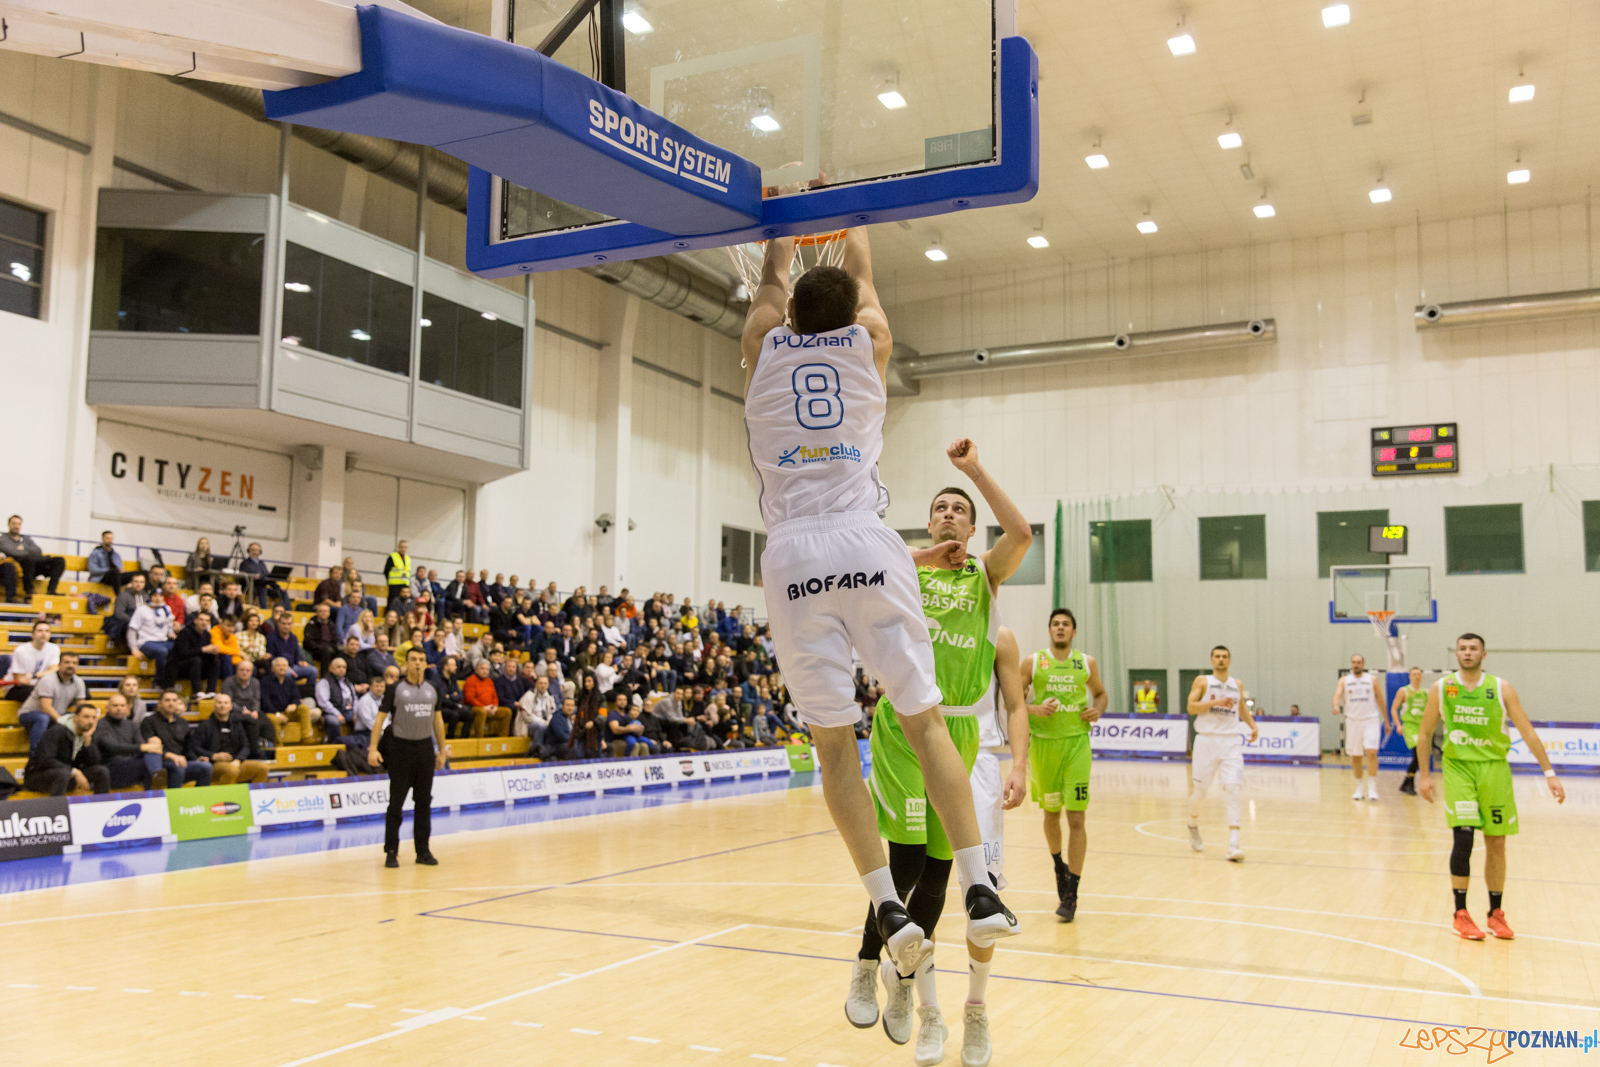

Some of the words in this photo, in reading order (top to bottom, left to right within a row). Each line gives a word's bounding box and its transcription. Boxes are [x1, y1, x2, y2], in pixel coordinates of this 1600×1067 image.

[589, 99, 659, 156] SPORT
[660, 136, 732, 185] SYSTEM
[792, 363, 845, 430] 8
[799, 443, 861, 459] funclub
[802, 456, 827, 464] biuro
[111, 452, 254, 500] CITYZEN
[787, 570, 885, 601] BIOFARM
[921, 592, 976, 613] BASKET
[1072, 659, 1083, 669] 15
[1048, 675, 1074, 684] ZNICZ
[1046, 684, 1078, 693] BASKET
[1486, 689, 1494, 699] 5
[1454, 705, 1485, 715] ZNICZ
[1453, 715, 1490, 726] BASKET
[1090, 725, 1169, 740] BIOFARM
[554, 772, 592, 784] BIOFARM
[346, 790, 389, 806] NICKEL
[1075, 786, 1088, 801] 15
[275, 796, 324, 809] funclub
[1492, 809, 1503, 824] 5
[983, 841, 1001, 866] 14
